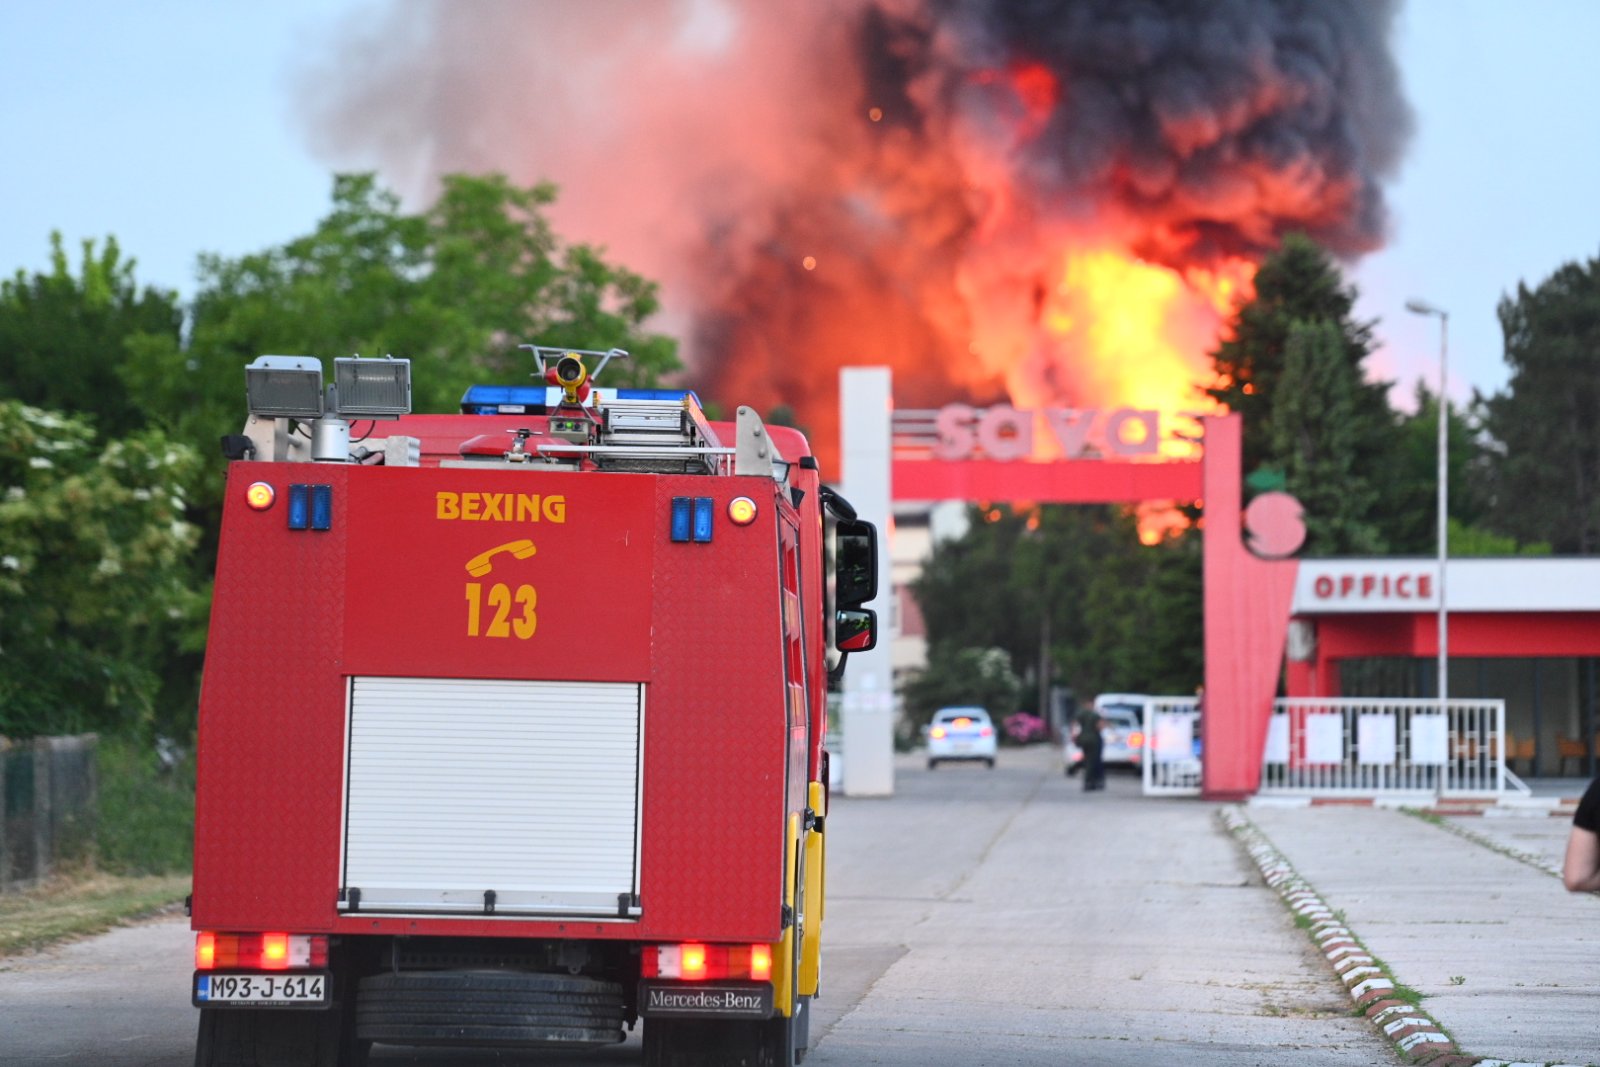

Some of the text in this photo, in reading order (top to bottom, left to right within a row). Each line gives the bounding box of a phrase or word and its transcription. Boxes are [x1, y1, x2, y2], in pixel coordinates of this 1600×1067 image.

[934, 404, 1158, 462] sava
[436, 491, 566, 523] BEXING
[1314, 574, 1433, 600] OFFICE
[465, 582, 537, 640] 123
[210, 977, 322, 998] M93-J-614
[650, 990, 762, 1009] Mercedes-Benz
